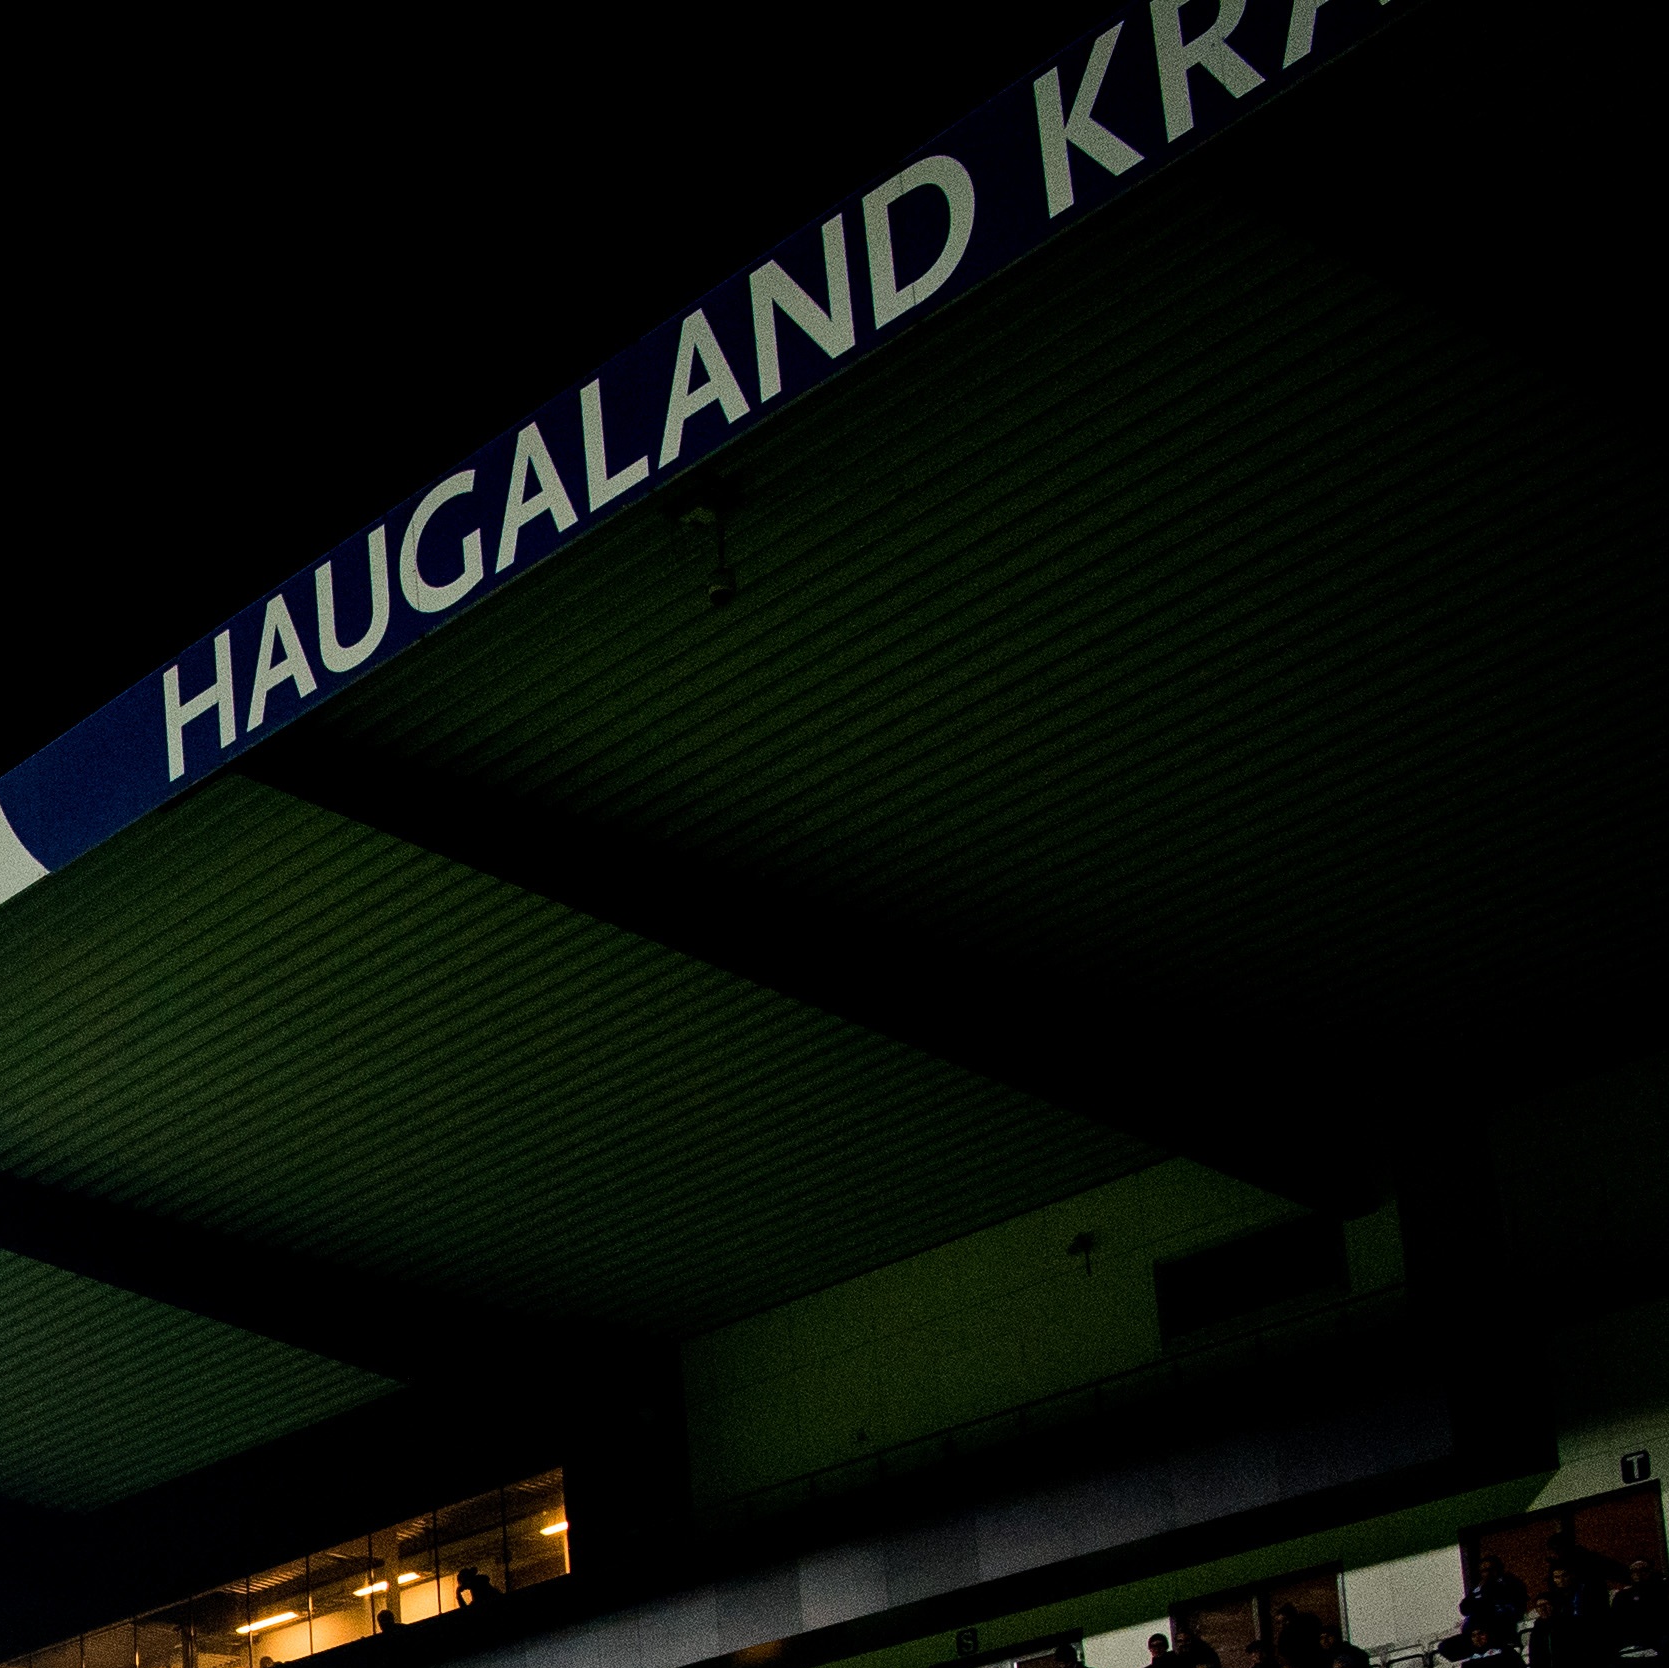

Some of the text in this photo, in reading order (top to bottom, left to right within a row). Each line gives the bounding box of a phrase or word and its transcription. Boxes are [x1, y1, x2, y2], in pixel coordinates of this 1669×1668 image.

[163, 0, 1327, 782] HAUGALAND KR
[1626, 1453, 1644, 1479] T
